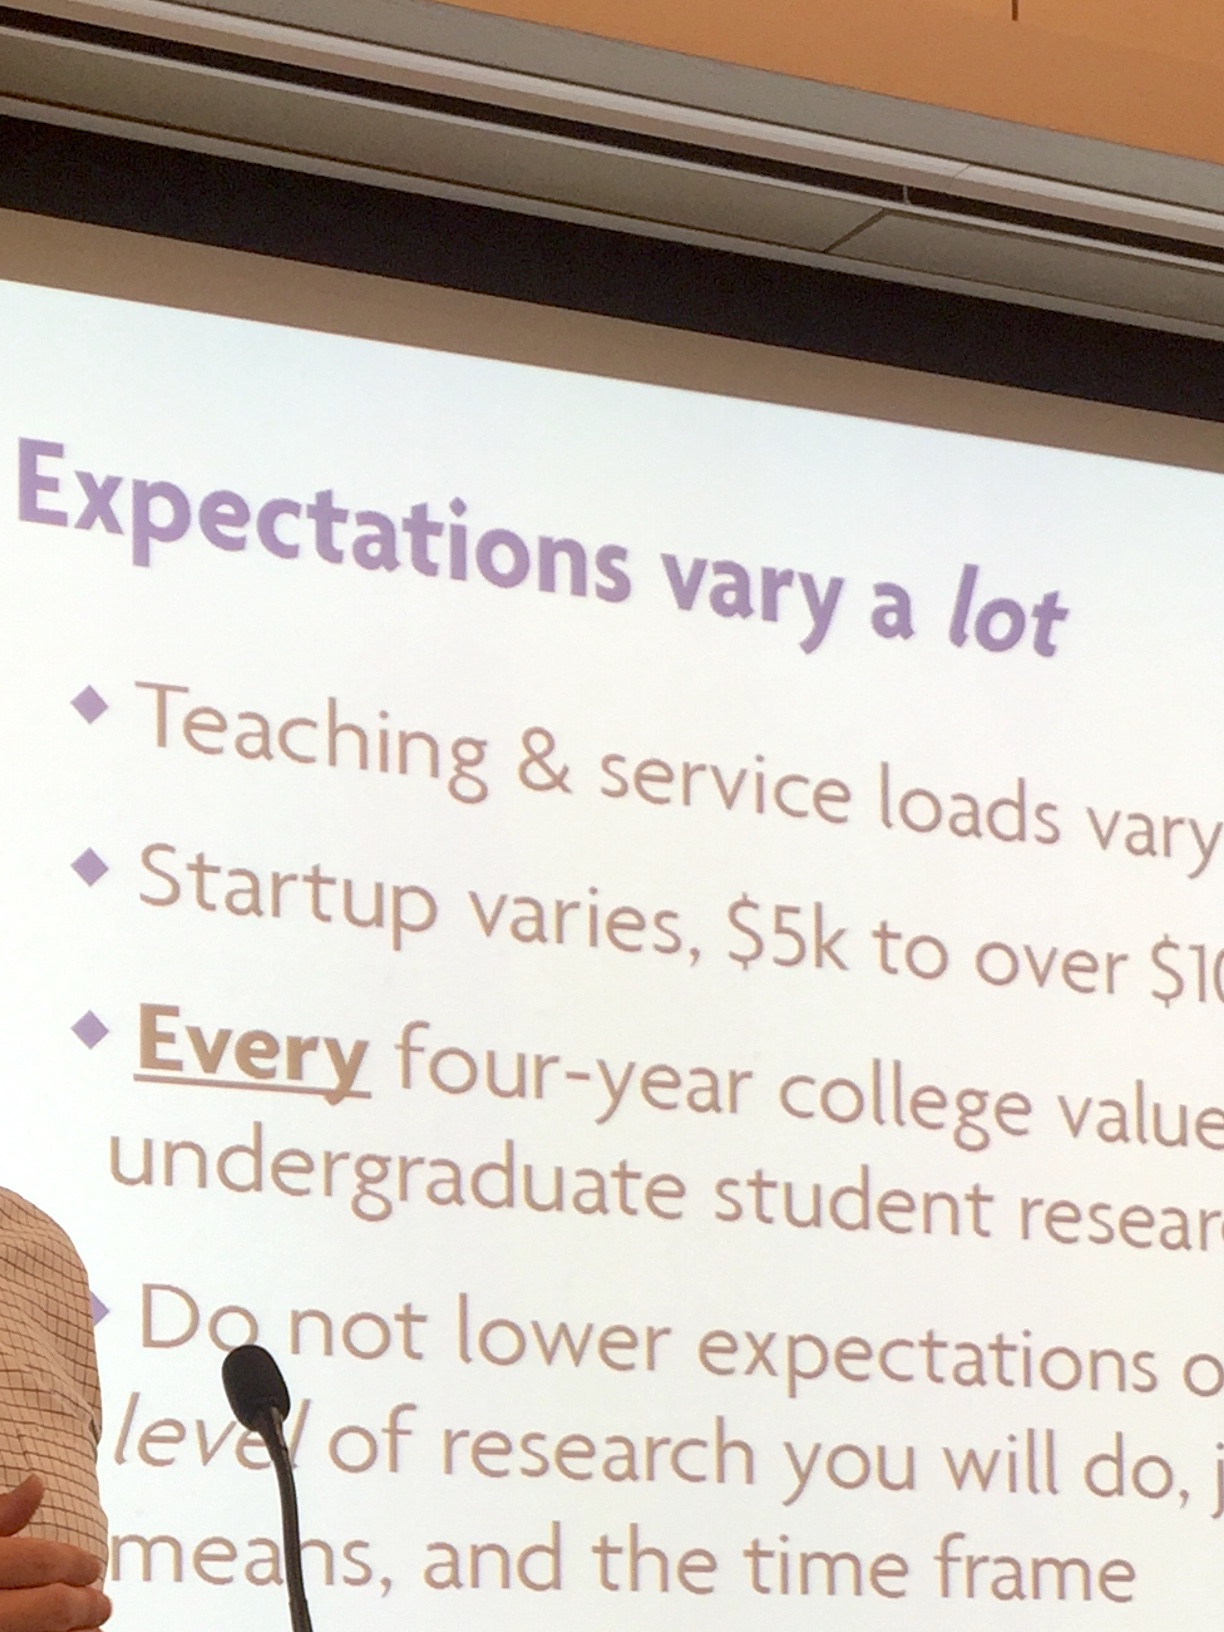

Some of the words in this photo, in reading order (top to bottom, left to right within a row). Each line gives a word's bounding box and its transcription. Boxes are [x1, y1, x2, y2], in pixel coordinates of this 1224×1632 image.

[18, 437, 632, 604] Expectations
[660, 553, 845, 655] vary
[871, 582, 916, 641] a
[949, 563, 1070, 658] lot
[135, 681, 489, 805] Teaching
[517, 726, 572, 794] &
[600, 753, 852, 825] service
[880, 761, 1061, 845] loads
[1086, 807, 1224, 880] vary
[139, 842, 438, 952] Startup
[468, 886, 701, 967] varies,
[727, 892, 848, 971] $5k
[871, 920, 949, 980] to
[975, 941, 1129, 995] over
[133, 1002, 373, 1107] Every
[394, 1020, 753, 1126] four-year
[779, 1057, 1032, 1153] college
[110, 1120, 686, 1223] undergraduate
[714, 1163, 995, 1238] student
[1020, 1197, 1224, 1252] resear
[141, 1282, 258, 1350] Do
[290, 1302, 428, 1361] not
[458, 1292, 672, 1372] lower
[697, 1329, 1158, 1399] expectations
[328, 1402, 418, 1474] of
[443, 1415, 755, 1485] research
[782, 1441, 916, 1508] you
[942, 1427, 1059, 1496] will
[1083, 1431, 1190, 1508] do,
[111, 1533, 391, 1598] means,
[423, 1520, 562, 1592] and
[591, 1522, 718, 1596] the
[742, 1534, 909, 1600] time
[933, 1531, 1136, 1604] frame
